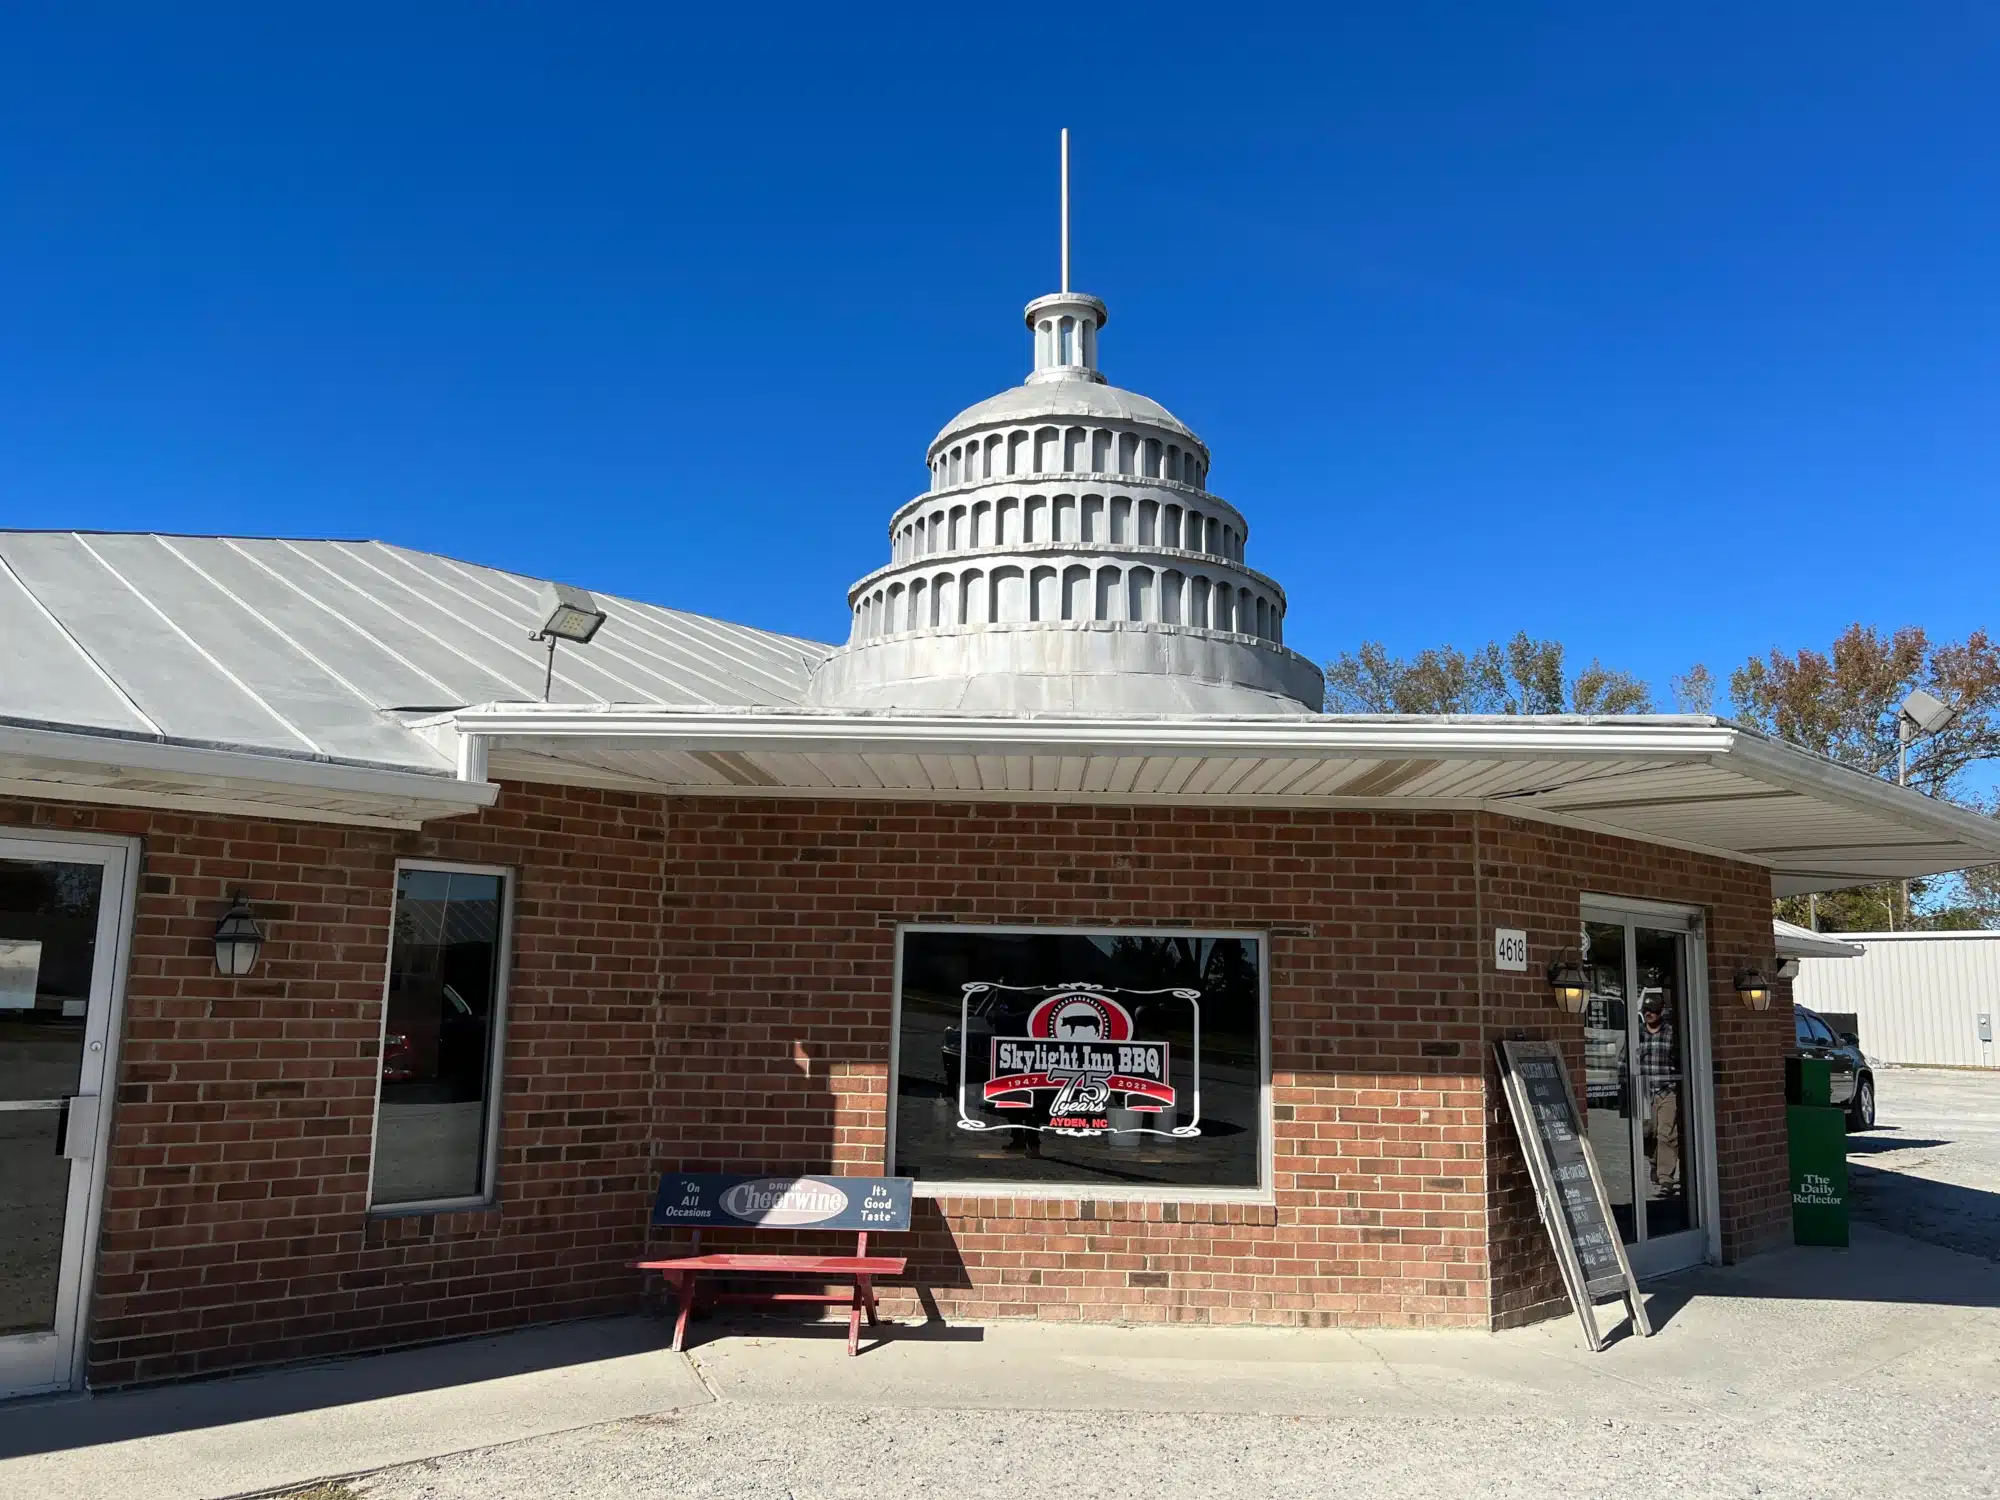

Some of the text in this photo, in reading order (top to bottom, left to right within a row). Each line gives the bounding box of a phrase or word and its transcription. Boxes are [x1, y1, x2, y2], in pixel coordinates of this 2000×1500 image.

[1499, 938, 1524, 962] 4618
[999, 1043, 1160, 1079] Skylight Inn BBQ
[1008, 1077, 1038, 1088] 1947
[1118, 1080, 1147, 1091] 2022
[1046, 1069, 1112, 1117] 75
[1056, 1100, 1106, 1117] years
[1049, 1117, 1109, 1129] AYDEN, NC
[1803, 1174, 1830, 1184] The
[768, 1182, 803, 1191] DRINK
[872, 1185, 887, 1197] It's
[1800, 1183, 1835, 1196] Daily
[681, 1196, 700, 1206] All
[726, 1184, 842, 1215] Cheerwine
[864, 1197, 892, 1209] Good
[1793, 1194, 1842, 1204] Reflector
[666, 1206, 712, 1217] Occasions
